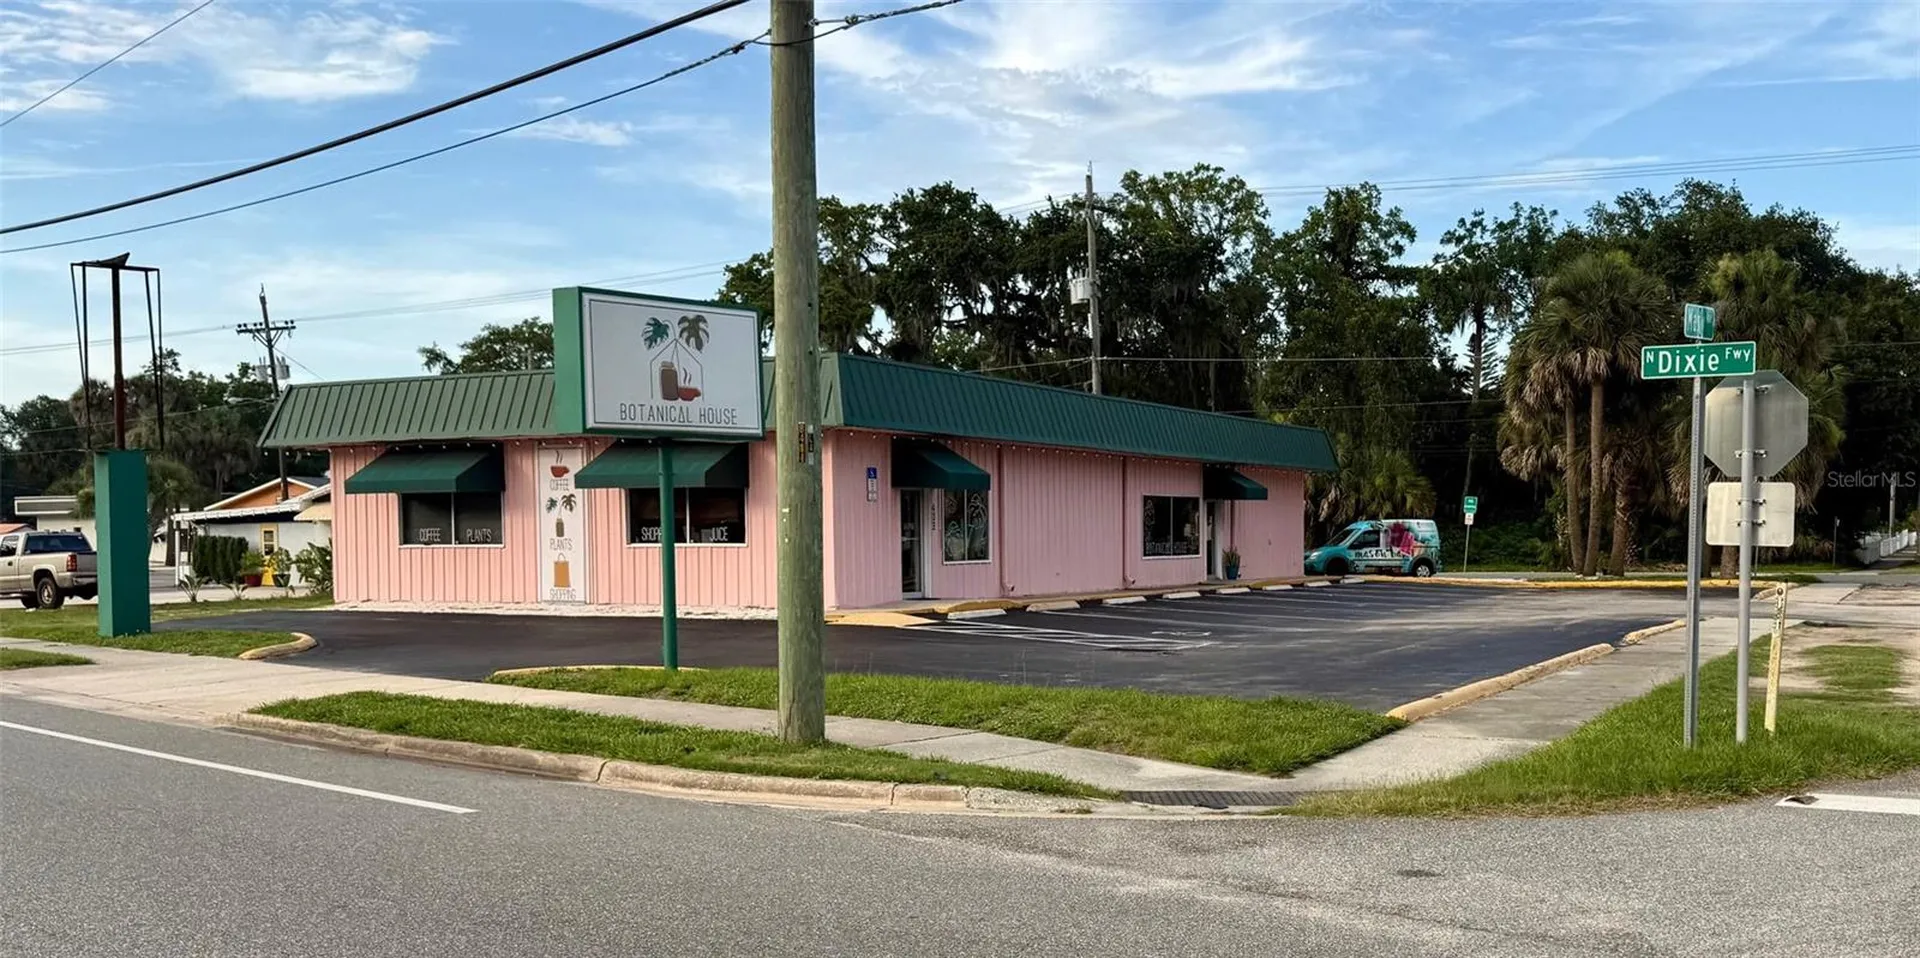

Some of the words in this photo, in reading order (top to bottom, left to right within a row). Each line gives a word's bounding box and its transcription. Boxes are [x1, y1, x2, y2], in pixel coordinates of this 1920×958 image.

[1646, 351, 1654, 363] N
[1658, 349, 1719, 374] Dixie
[1725, 347, 1751, 362] Fwy
[620, 402, 692, 424] BOTANICAL
[699, 407, 737, 425] HOUSE
[550, 478, 569, 491] COFFEE
[419, 527, 440, 542] COFFEE
[466, 528, 492, 542] PLANTS
[641, 526, 662, 541] SHOPP
[710, 526, 728, 541] JUICE
[550, 538, 572, 551] PLANTS
